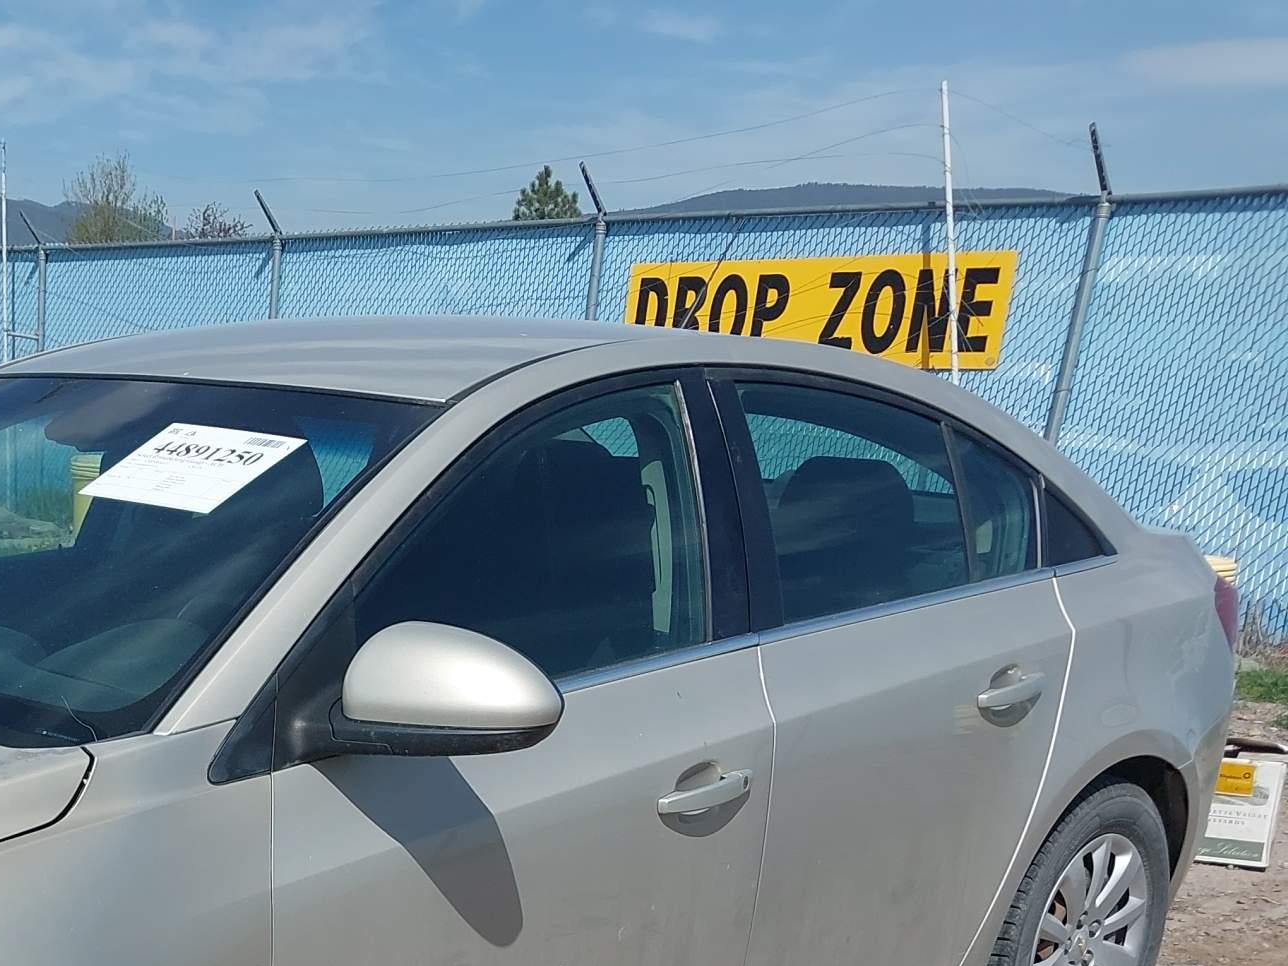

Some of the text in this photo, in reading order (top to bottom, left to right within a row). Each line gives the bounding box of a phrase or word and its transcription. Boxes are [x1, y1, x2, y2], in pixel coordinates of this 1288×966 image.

[635, 267, 1000, 354] DROP ZONE
[153, 440, 265, 467] 44891250
